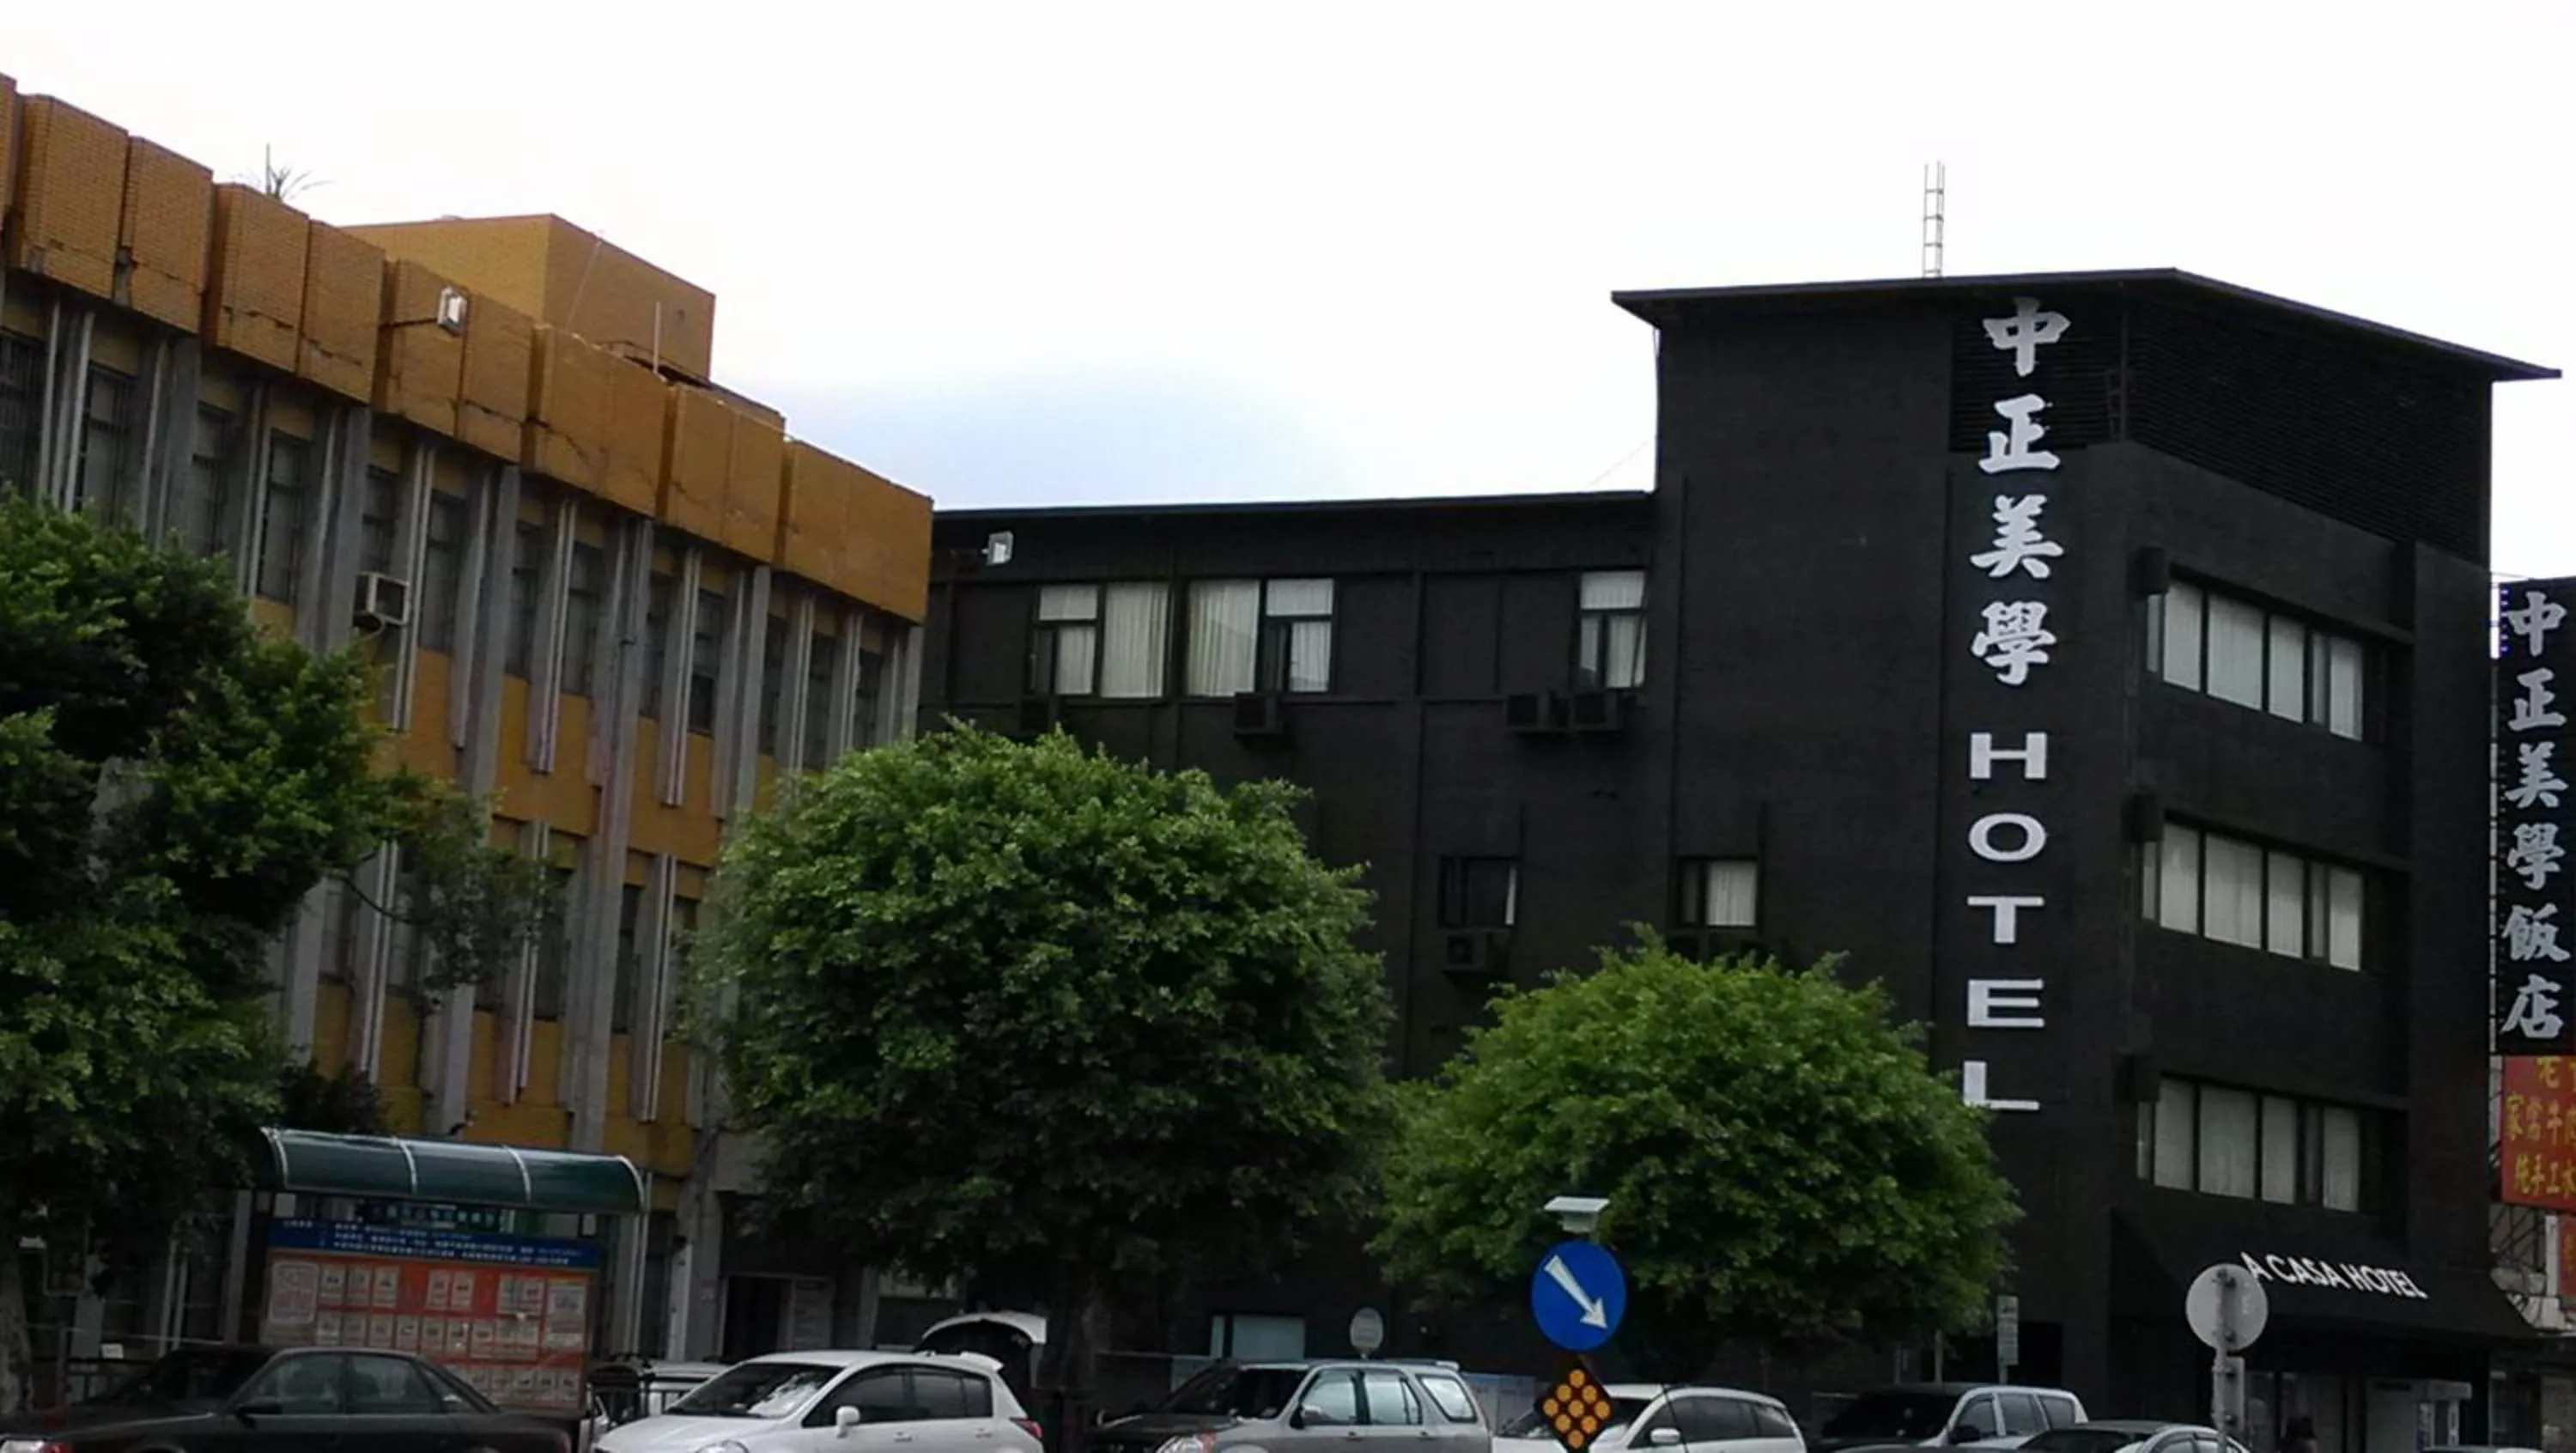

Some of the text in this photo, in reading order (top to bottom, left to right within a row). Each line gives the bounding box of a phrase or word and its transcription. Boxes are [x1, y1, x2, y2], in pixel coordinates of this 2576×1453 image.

[1962, 295, 2071, 1110] 中正美學 HOTEL
[2500, 590, 2571, 1040] 中正美學飯店
[2239, 1250, 2429, 1299] A CASA HOTEL
